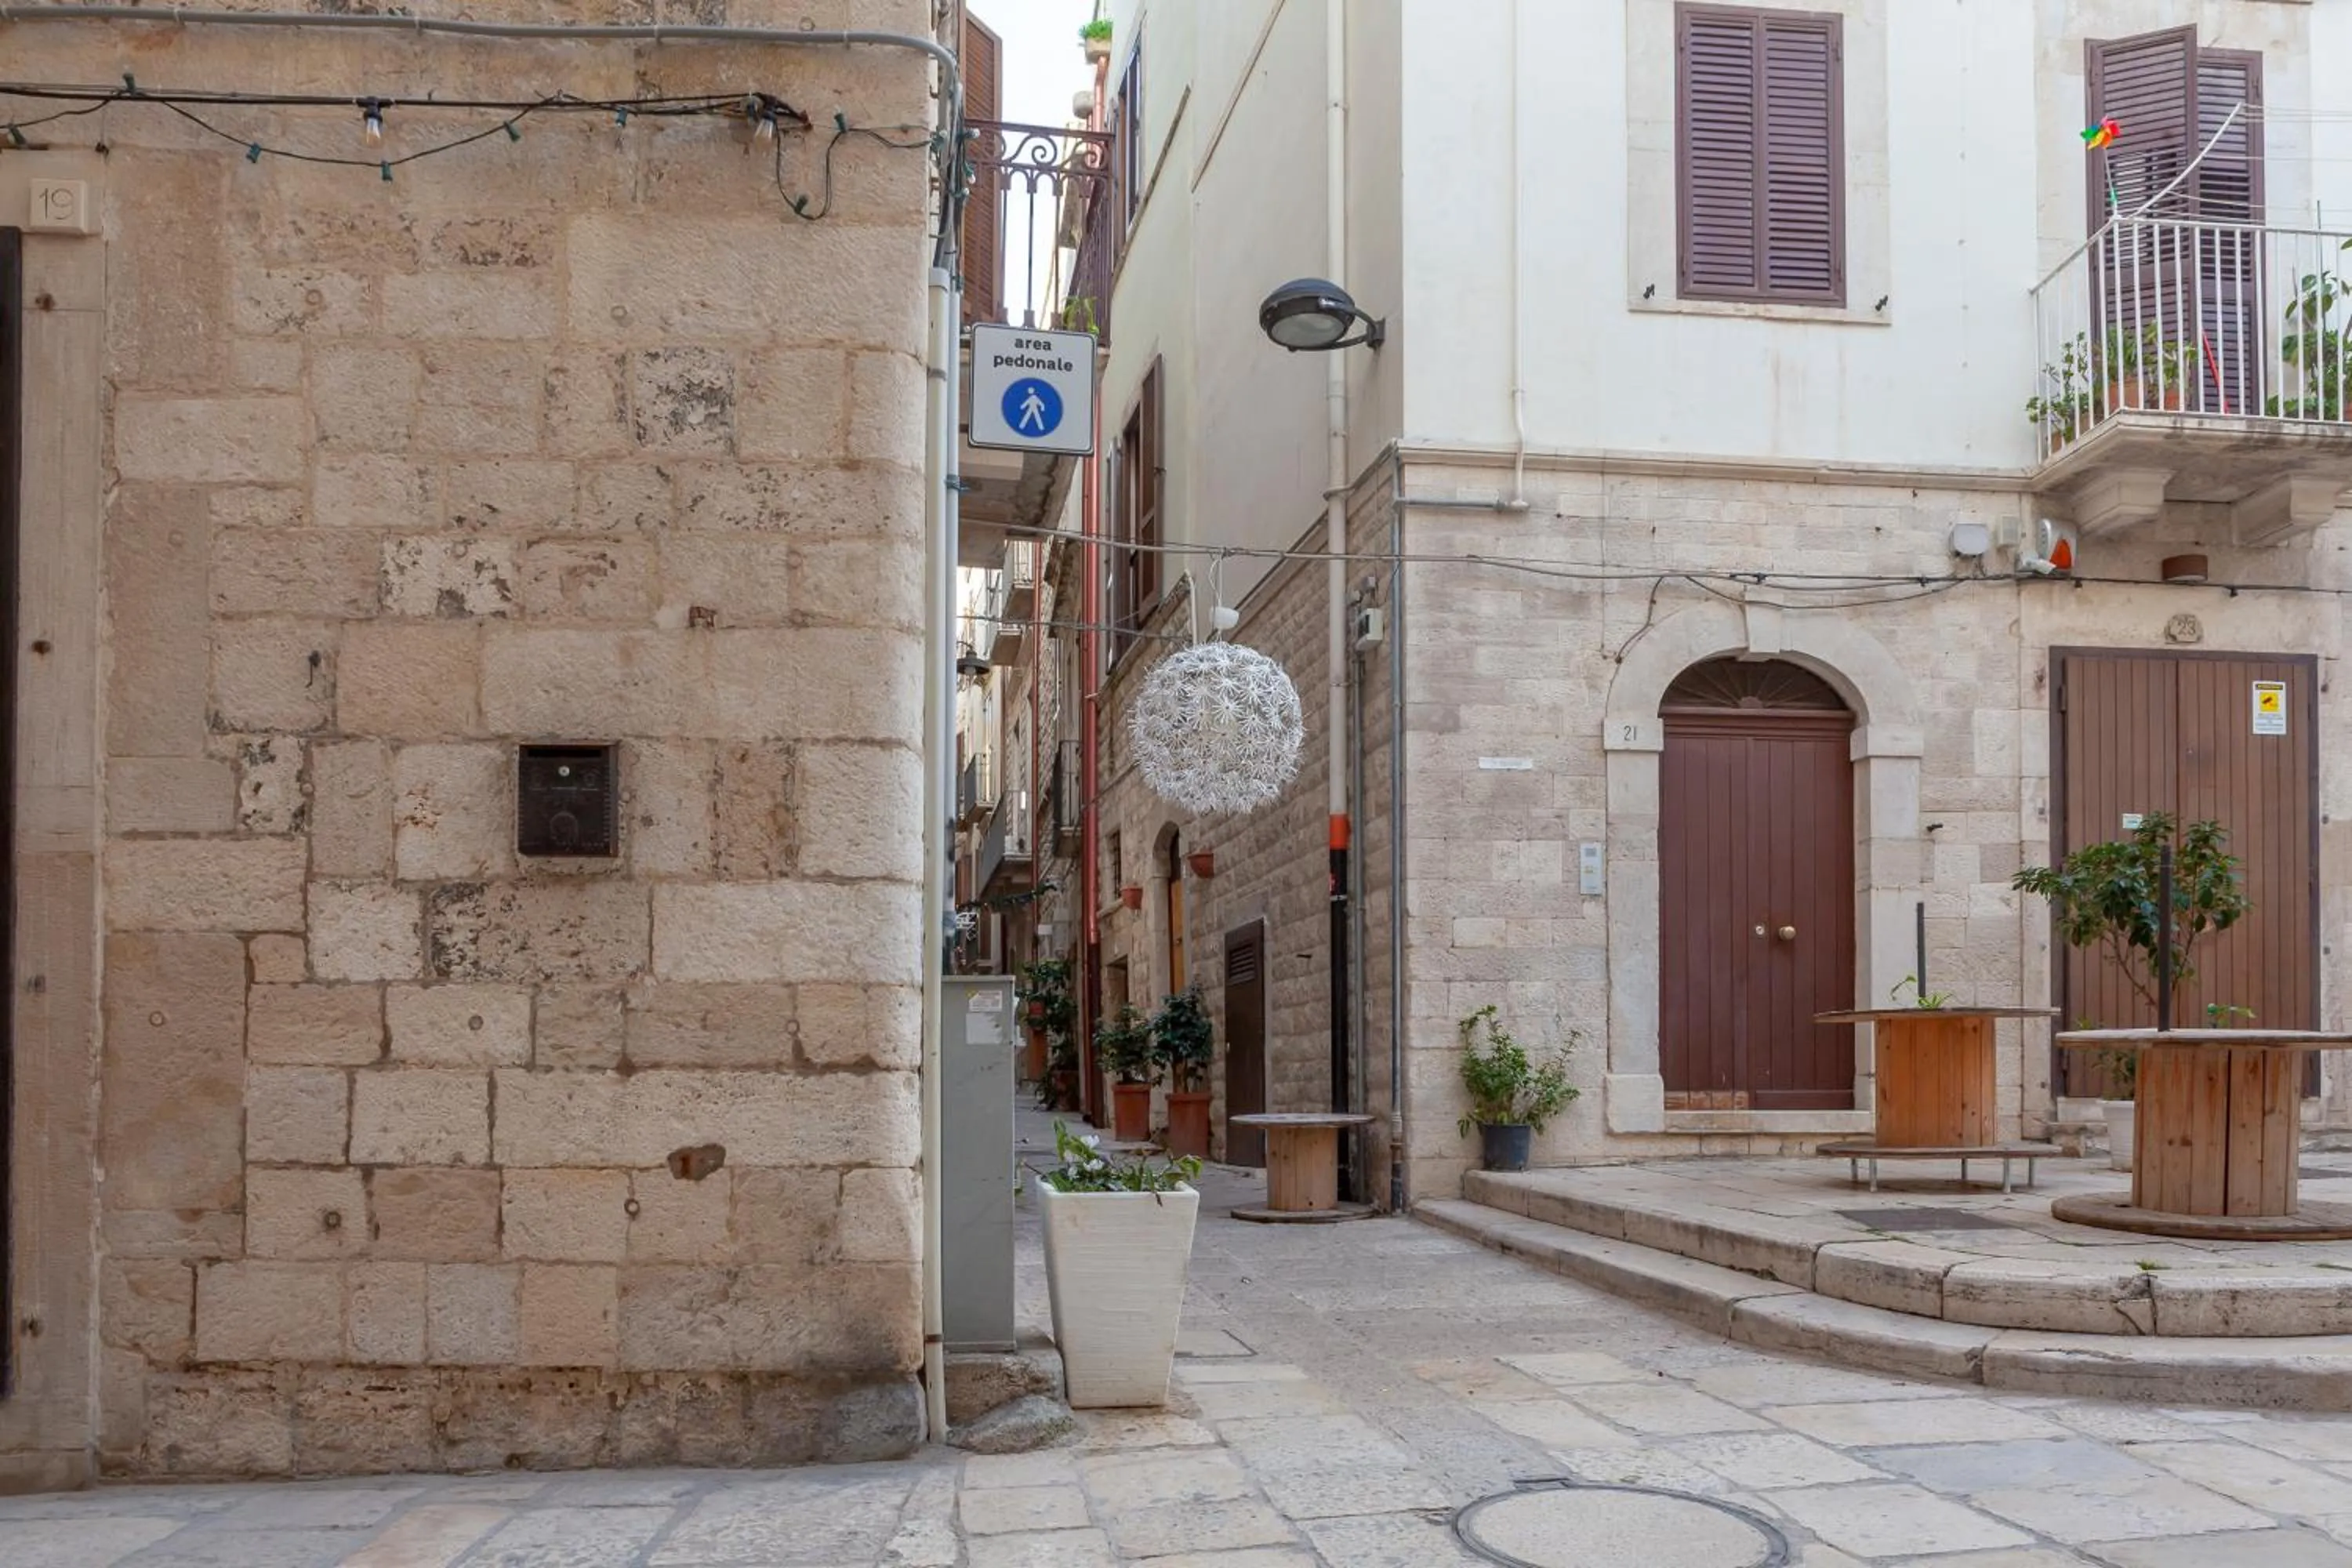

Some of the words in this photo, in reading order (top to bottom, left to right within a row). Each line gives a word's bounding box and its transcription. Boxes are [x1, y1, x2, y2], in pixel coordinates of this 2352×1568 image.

[39, 187, 74, 220] 19
[1014, 338, 1051, 350] area
[993, 354, 1073, 372] pedonale
[2178, 619, 2196, 635] 23
[1624, 725, 1637, 741] 21
